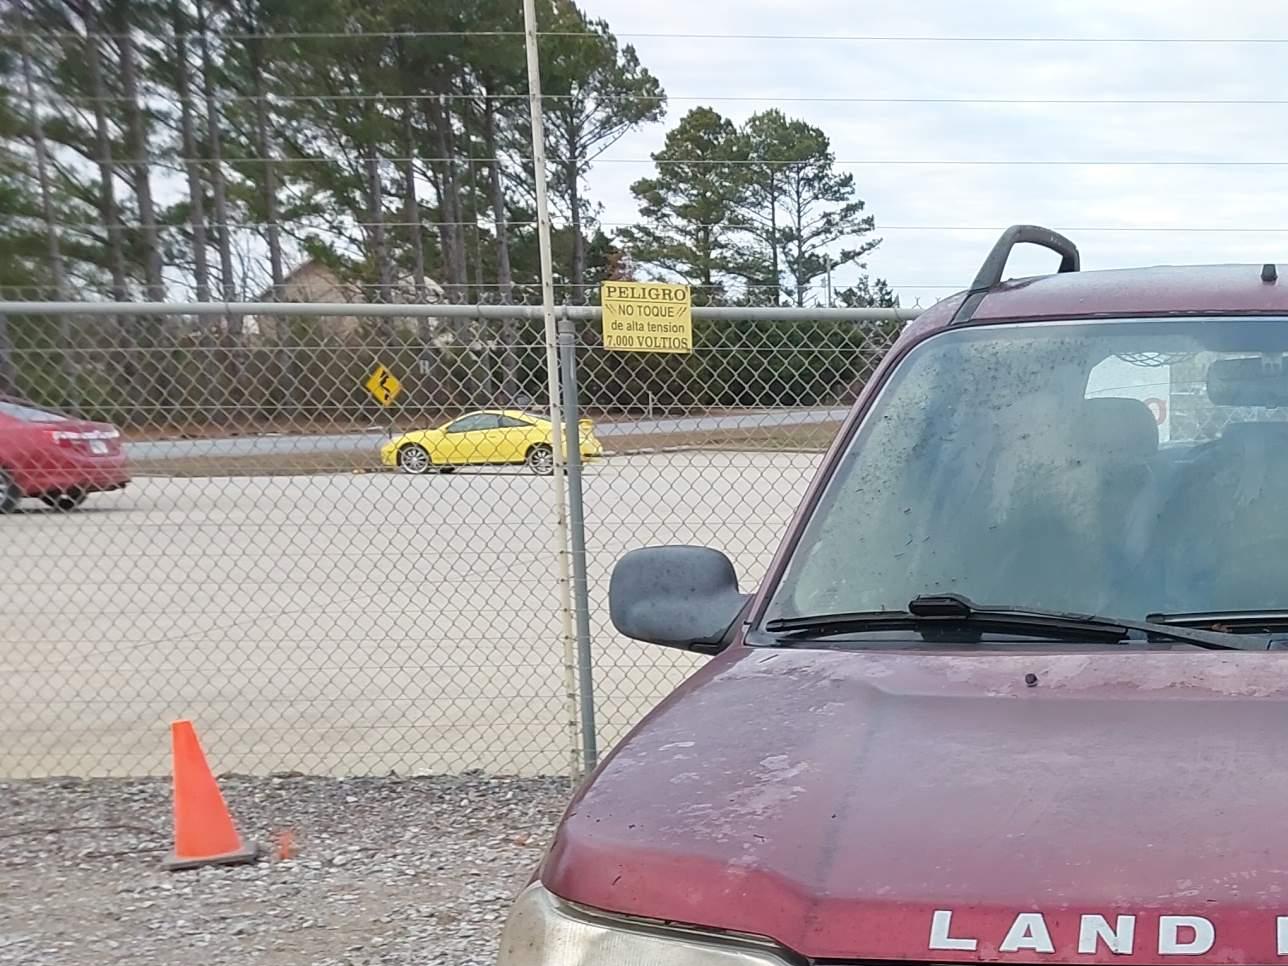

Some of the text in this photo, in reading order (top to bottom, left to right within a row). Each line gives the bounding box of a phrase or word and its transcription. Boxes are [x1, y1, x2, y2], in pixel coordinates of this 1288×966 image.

[606, 286, 686, 301] PELIGRO
[618, 304, 675, 318] NO TOQUE
[611, 320, 685, 333] de alta tension
[636, 335, 688, 350] VOLTIOS
[929, 909, 1216, 956] LAND
